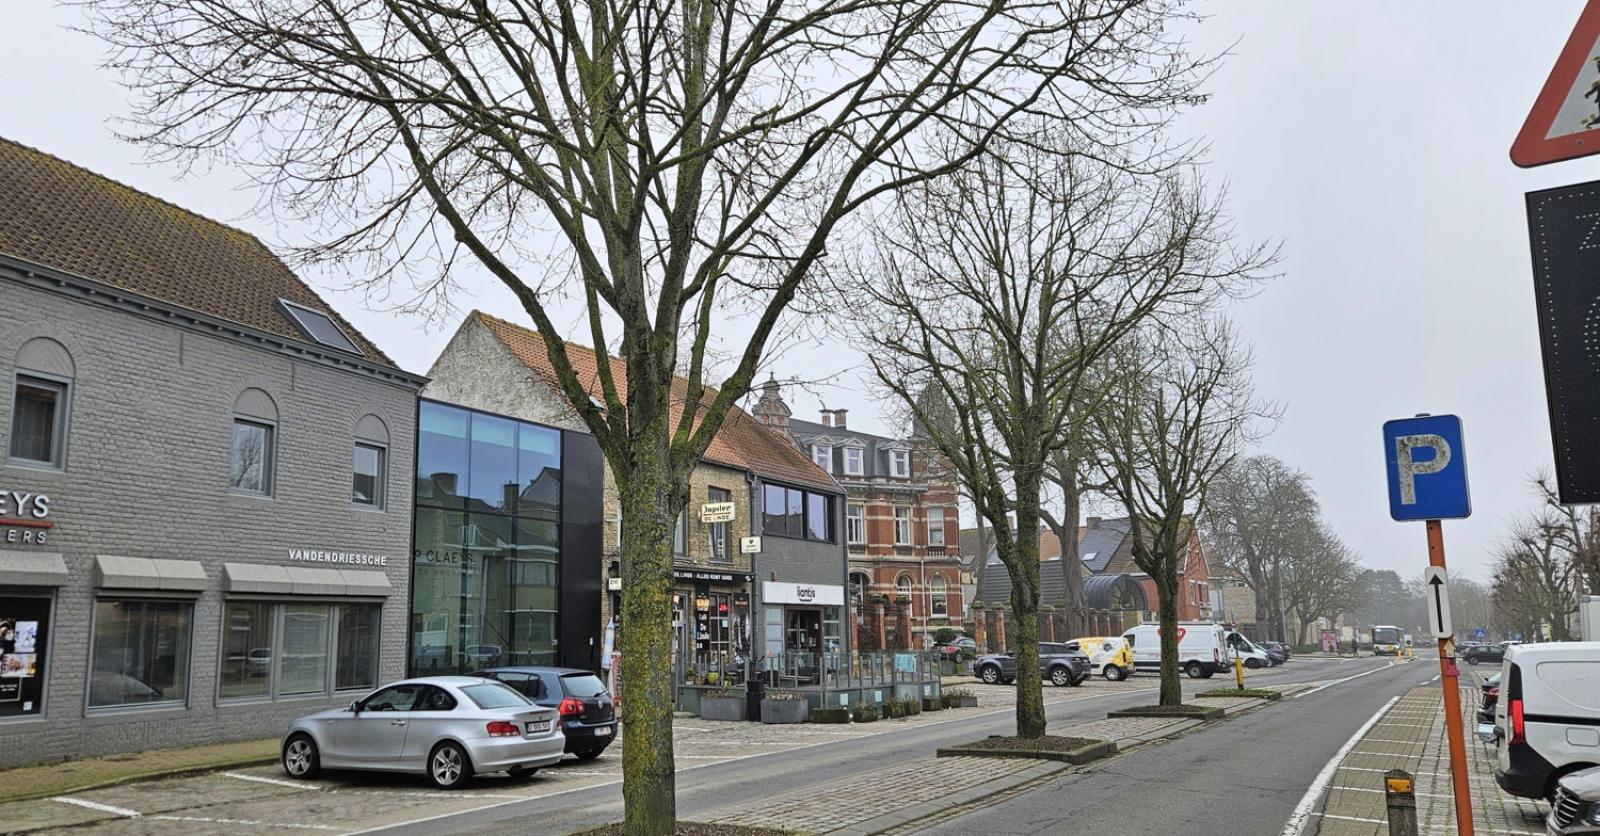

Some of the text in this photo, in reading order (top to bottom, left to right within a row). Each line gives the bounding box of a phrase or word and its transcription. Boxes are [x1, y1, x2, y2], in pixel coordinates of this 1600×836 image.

[1395, 433, 1452, 505] P
[704, 504, 731, 513] Jupiler
[288, 549, 387, 566] VANDENDRIESSCHE
[797, 585, 815, 598] liantis
